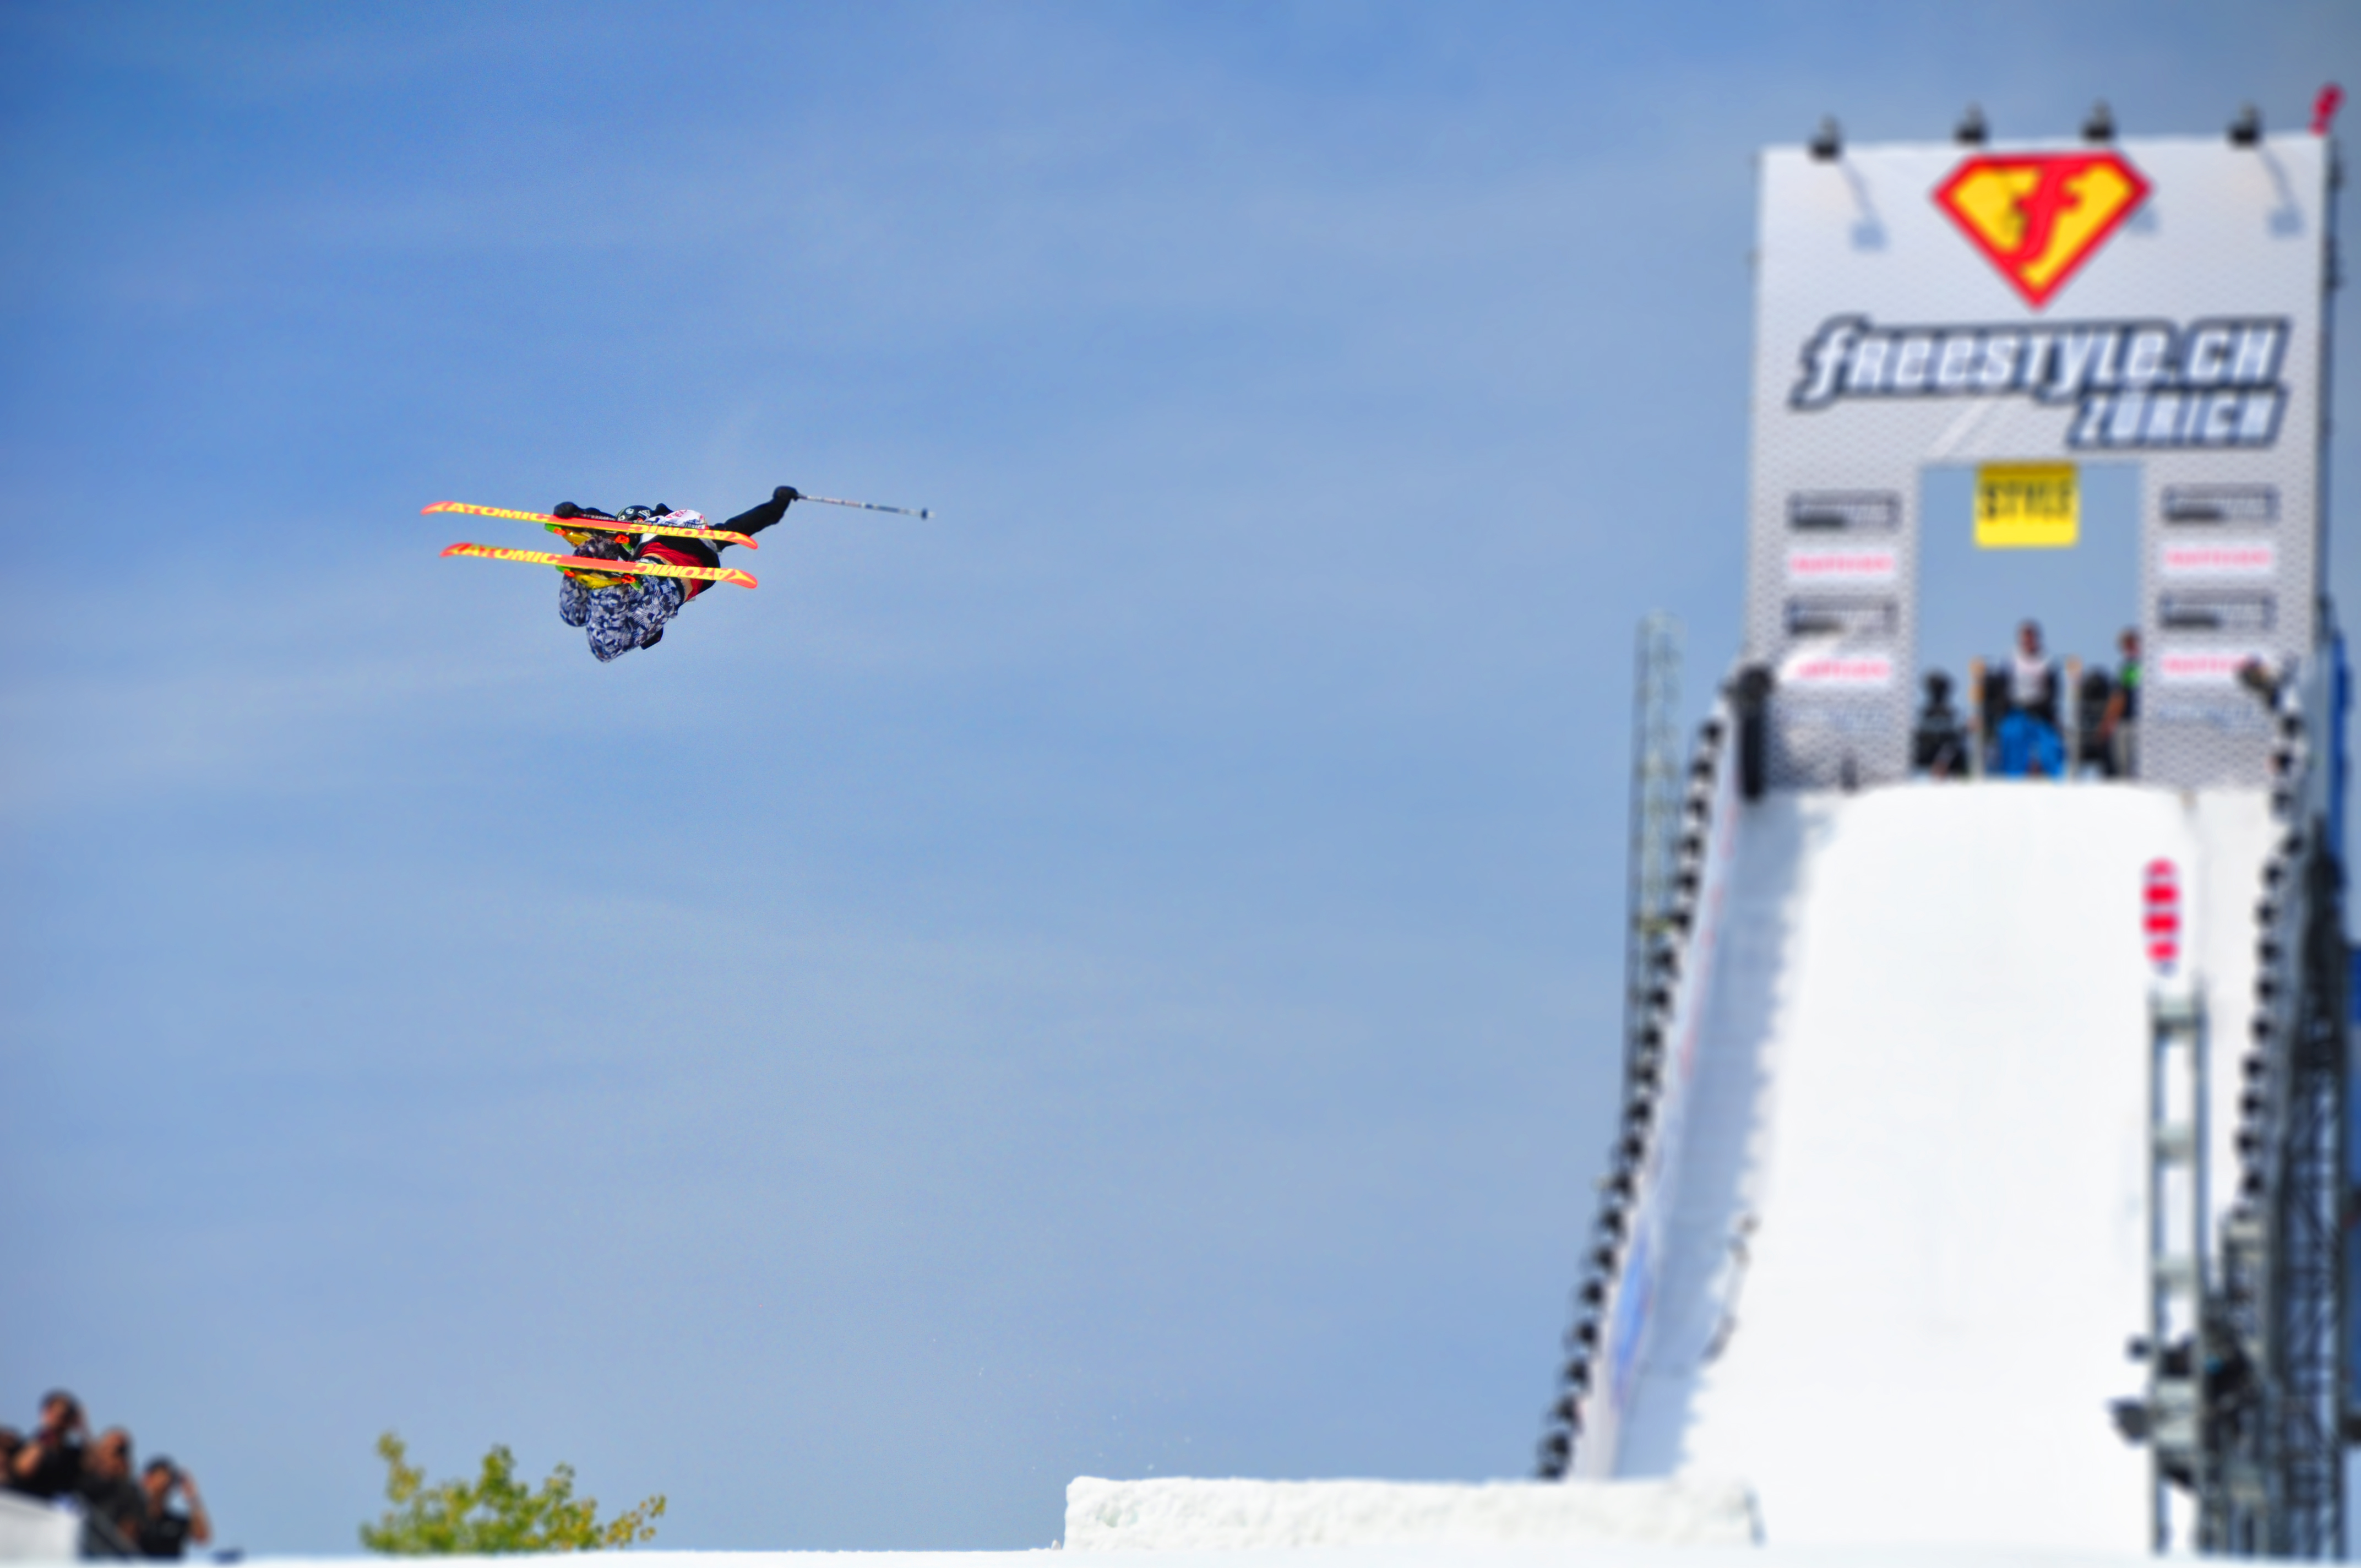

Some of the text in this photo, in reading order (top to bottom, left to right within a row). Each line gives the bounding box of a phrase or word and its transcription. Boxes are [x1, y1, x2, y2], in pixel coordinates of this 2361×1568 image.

[448, 502, 551, 522] ATOMIC
[628, 524, 732, 540] ATOMIC
[463, 546, 562, 565] ATOMIC
[633, 563, 733, 581] ATOMIC
